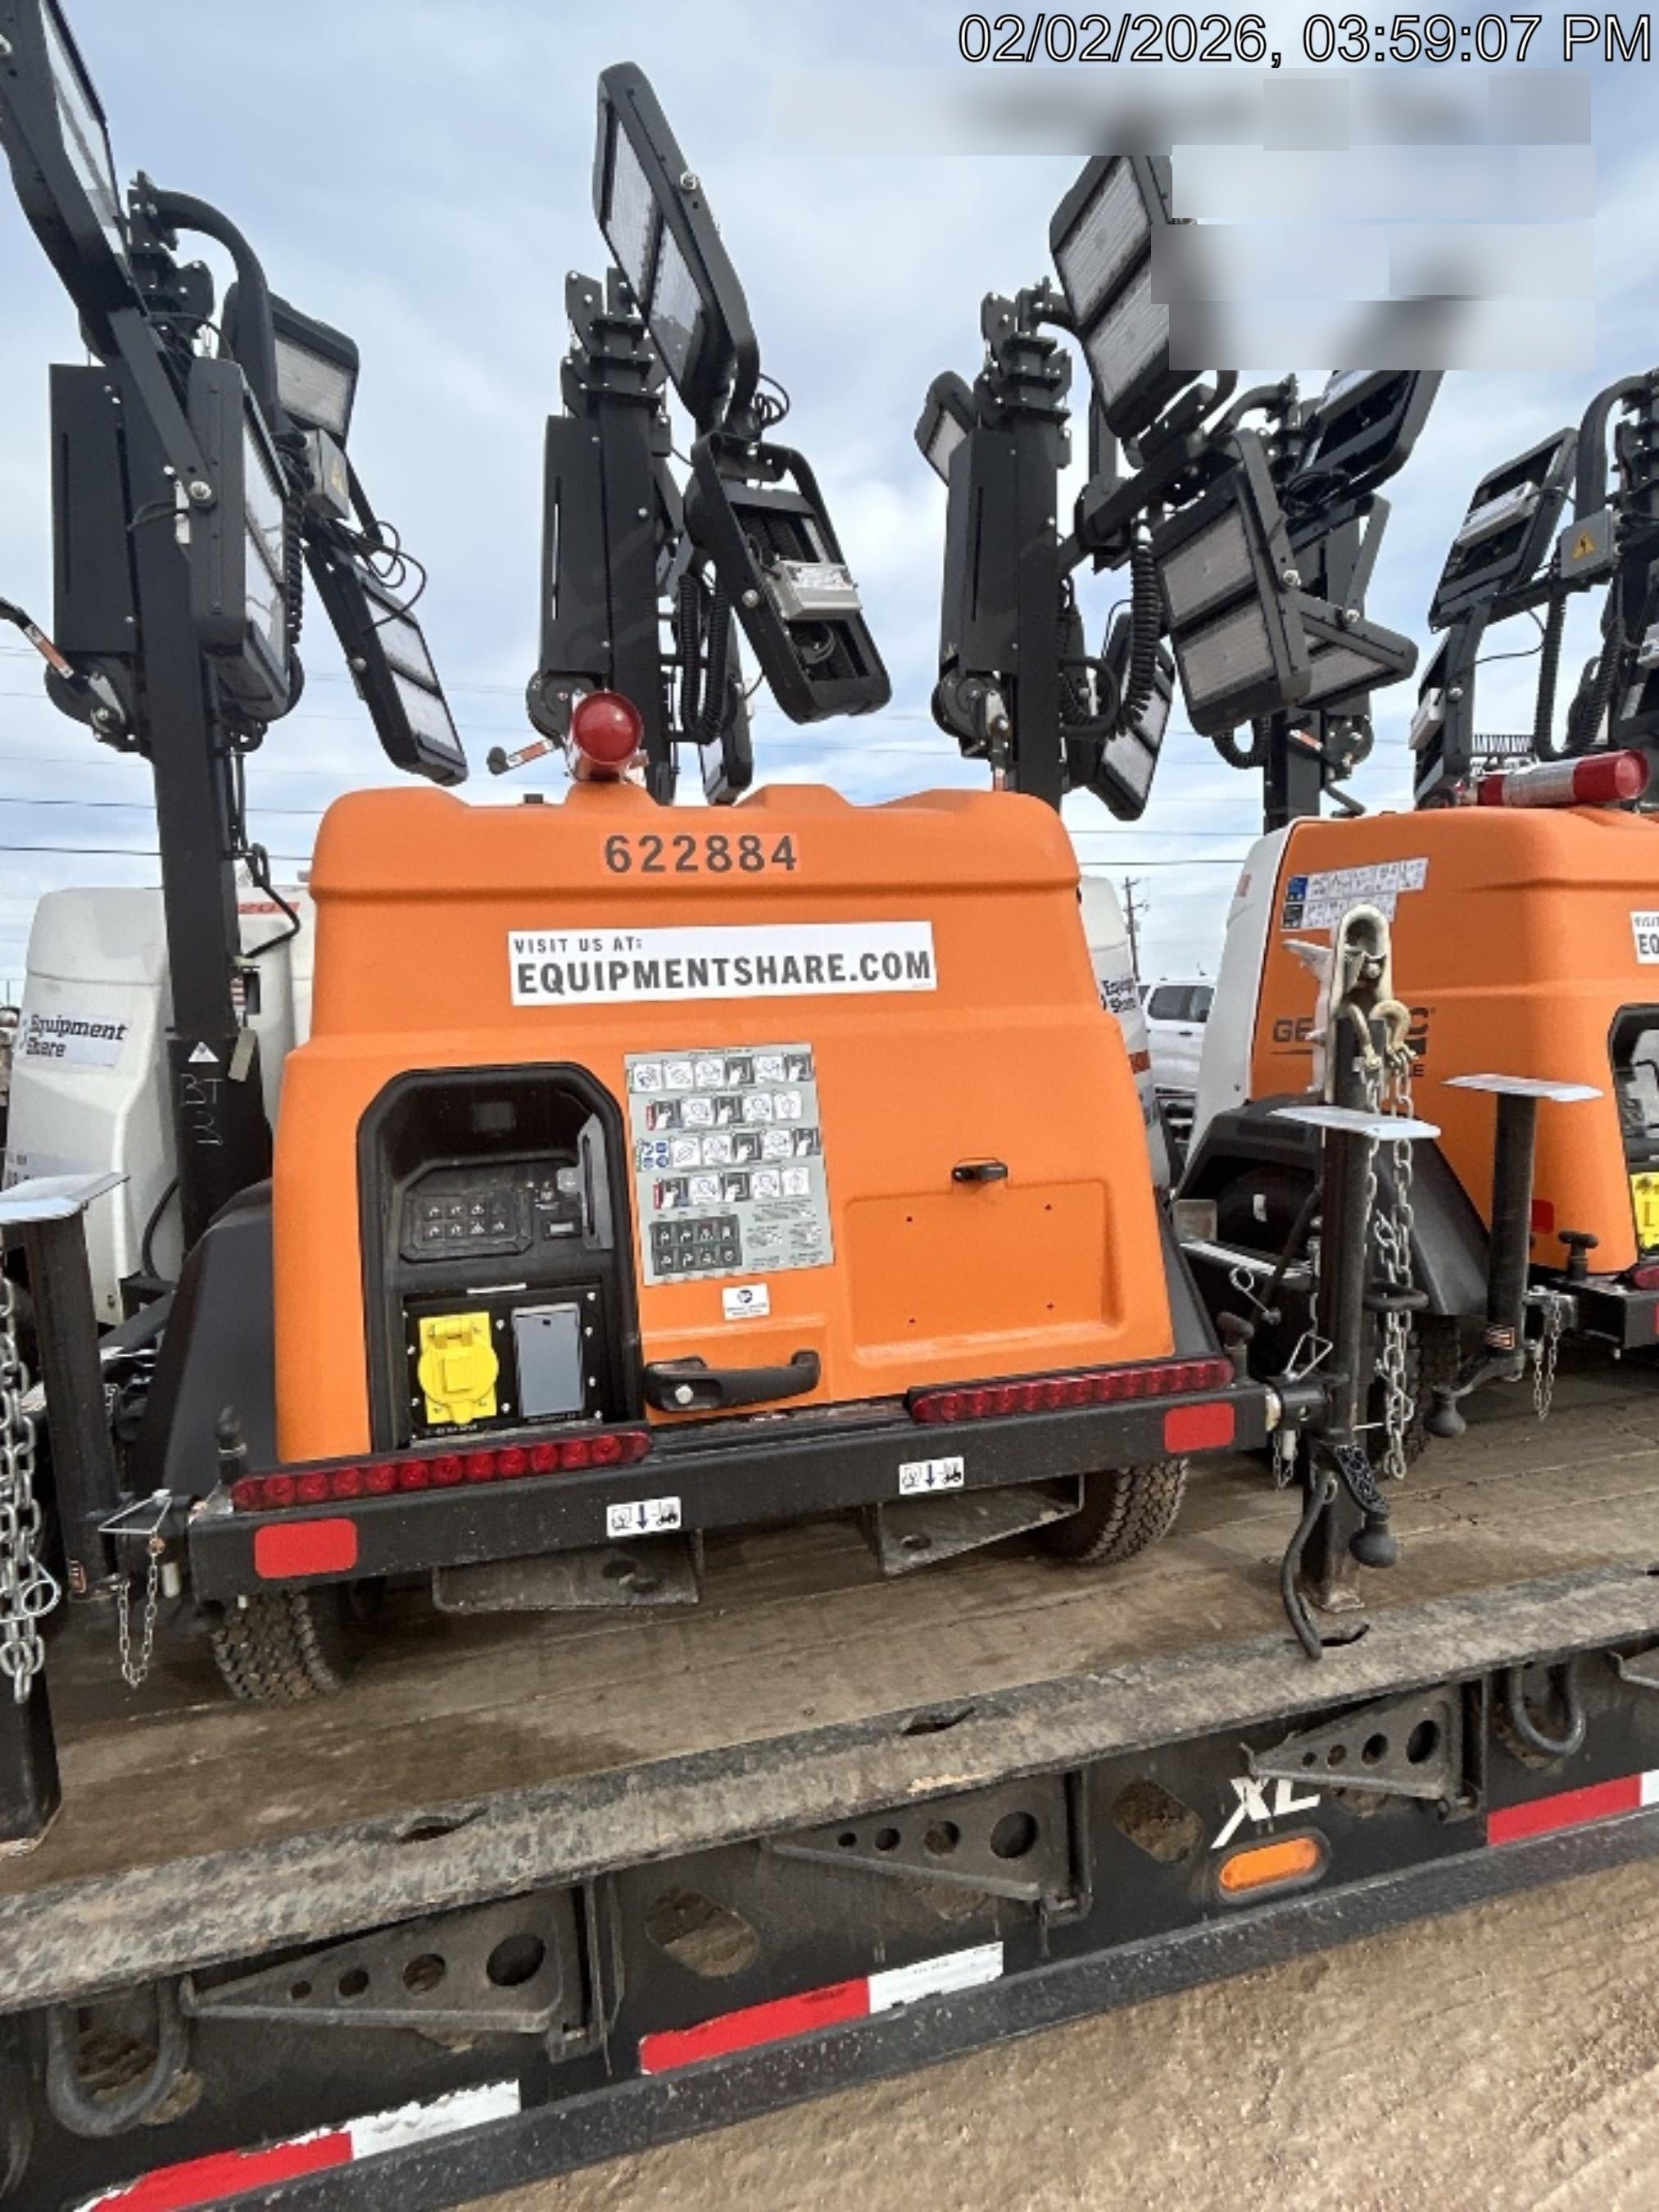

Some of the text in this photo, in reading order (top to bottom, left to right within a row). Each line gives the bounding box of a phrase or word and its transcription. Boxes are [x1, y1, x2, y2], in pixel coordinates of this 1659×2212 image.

[604, 834, 798, 873] 622884
[514, 936, 642, 954] VISIT US AT:
[517, 950, 932, 995] EQUIPMENTSHARE.COM
[1209, 1776, 1321, 1850] XL
